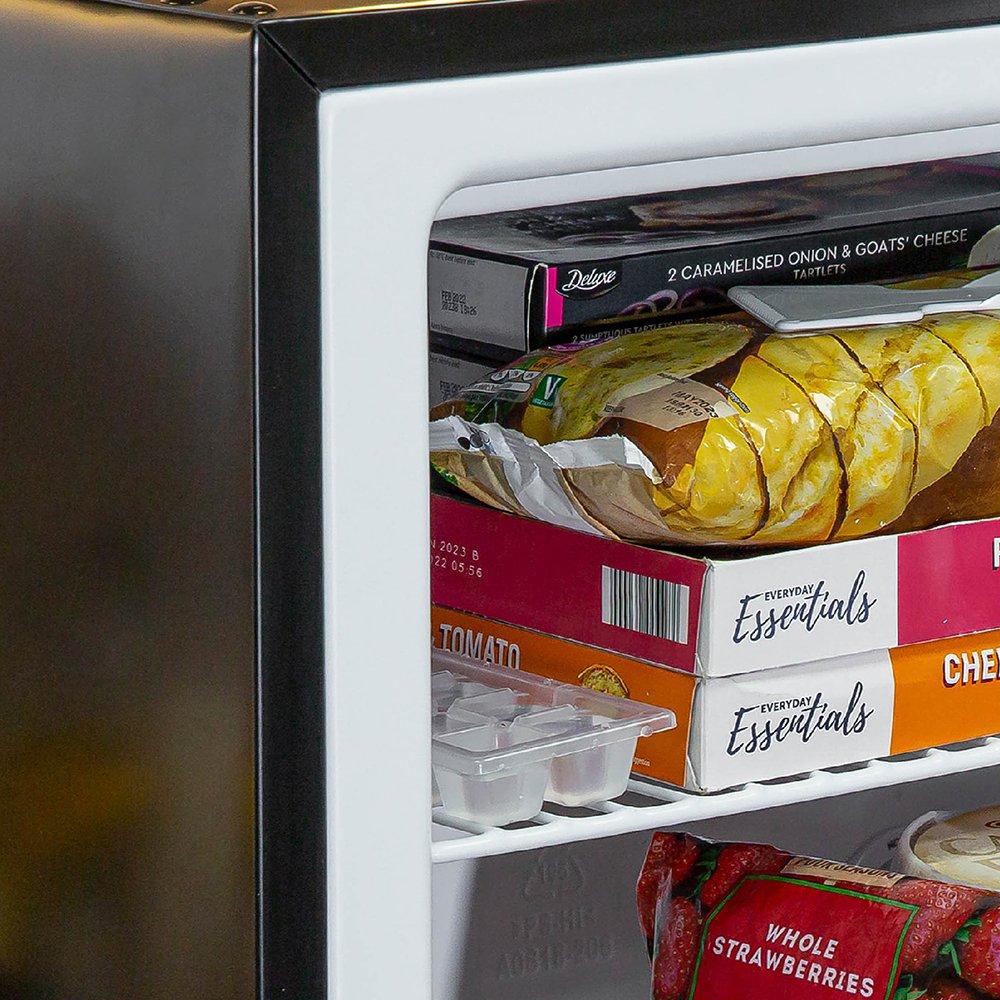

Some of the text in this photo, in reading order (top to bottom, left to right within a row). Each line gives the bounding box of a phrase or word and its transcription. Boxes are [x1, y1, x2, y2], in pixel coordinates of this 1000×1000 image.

[668, 228, 968, 282] 2 CARAMELISED ONION & GOATS' CHEESE
[793, 264, 847, 280] TARTLETS
[562, 268, 617, 292] Deluxe
[440, 541, 480, 561] 2023 B
[733, 570, 878, 643] Essentials
[764, 584, 814, 601] EVERYDAY
[439, 623, 520, 670] TOMATO
[726, 681, 874, 756] Essentials
[760, 696, 812, 714] EVERYDAY
[765, 923, 839, 960] WHOLE
[712, 936, 875, 998] STRAWBERRIES
